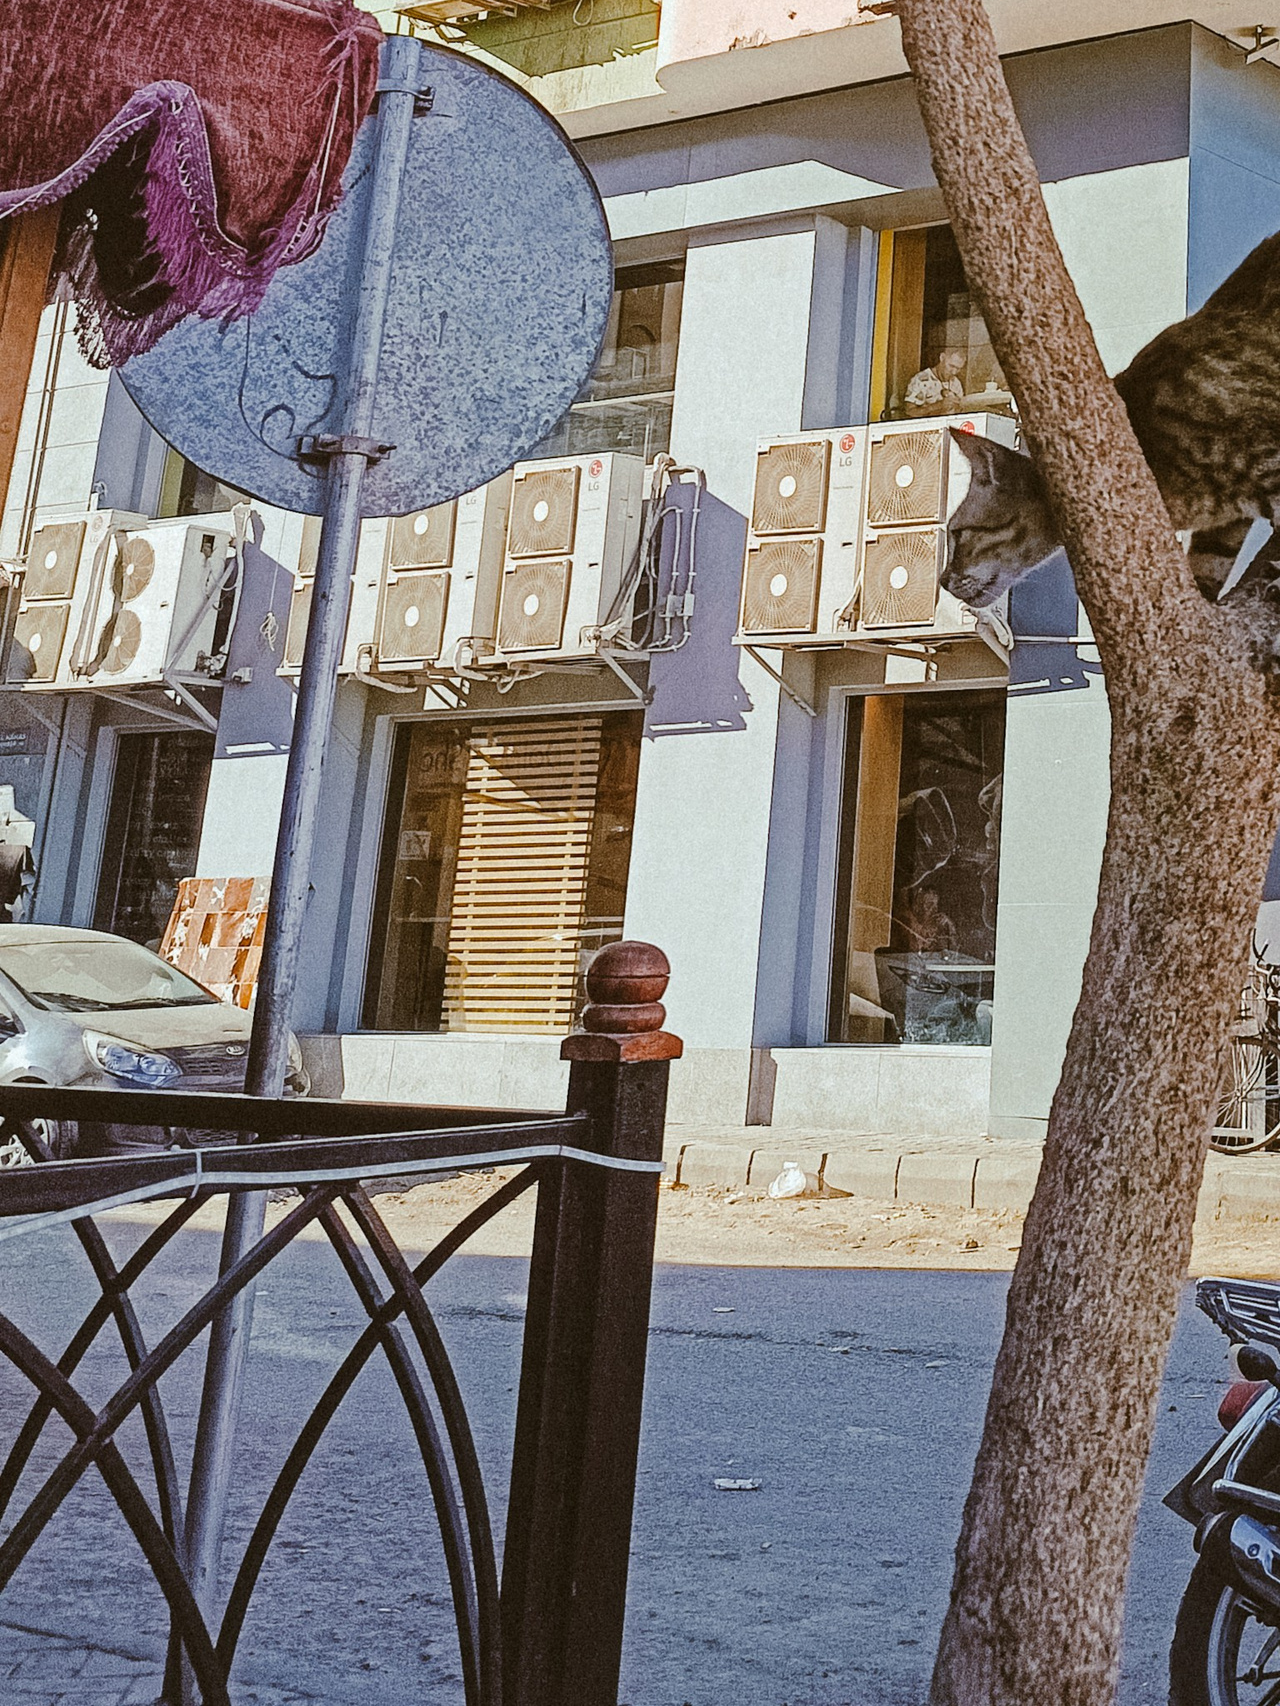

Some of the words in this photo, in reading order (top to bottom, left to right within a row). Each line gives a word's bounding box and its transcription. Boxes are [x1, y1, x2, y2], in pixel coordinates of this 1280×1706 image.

[839, 456, 853, 467] LG
[588, 481, 600, 492] LG
[466, 496, 477, 505] LG
